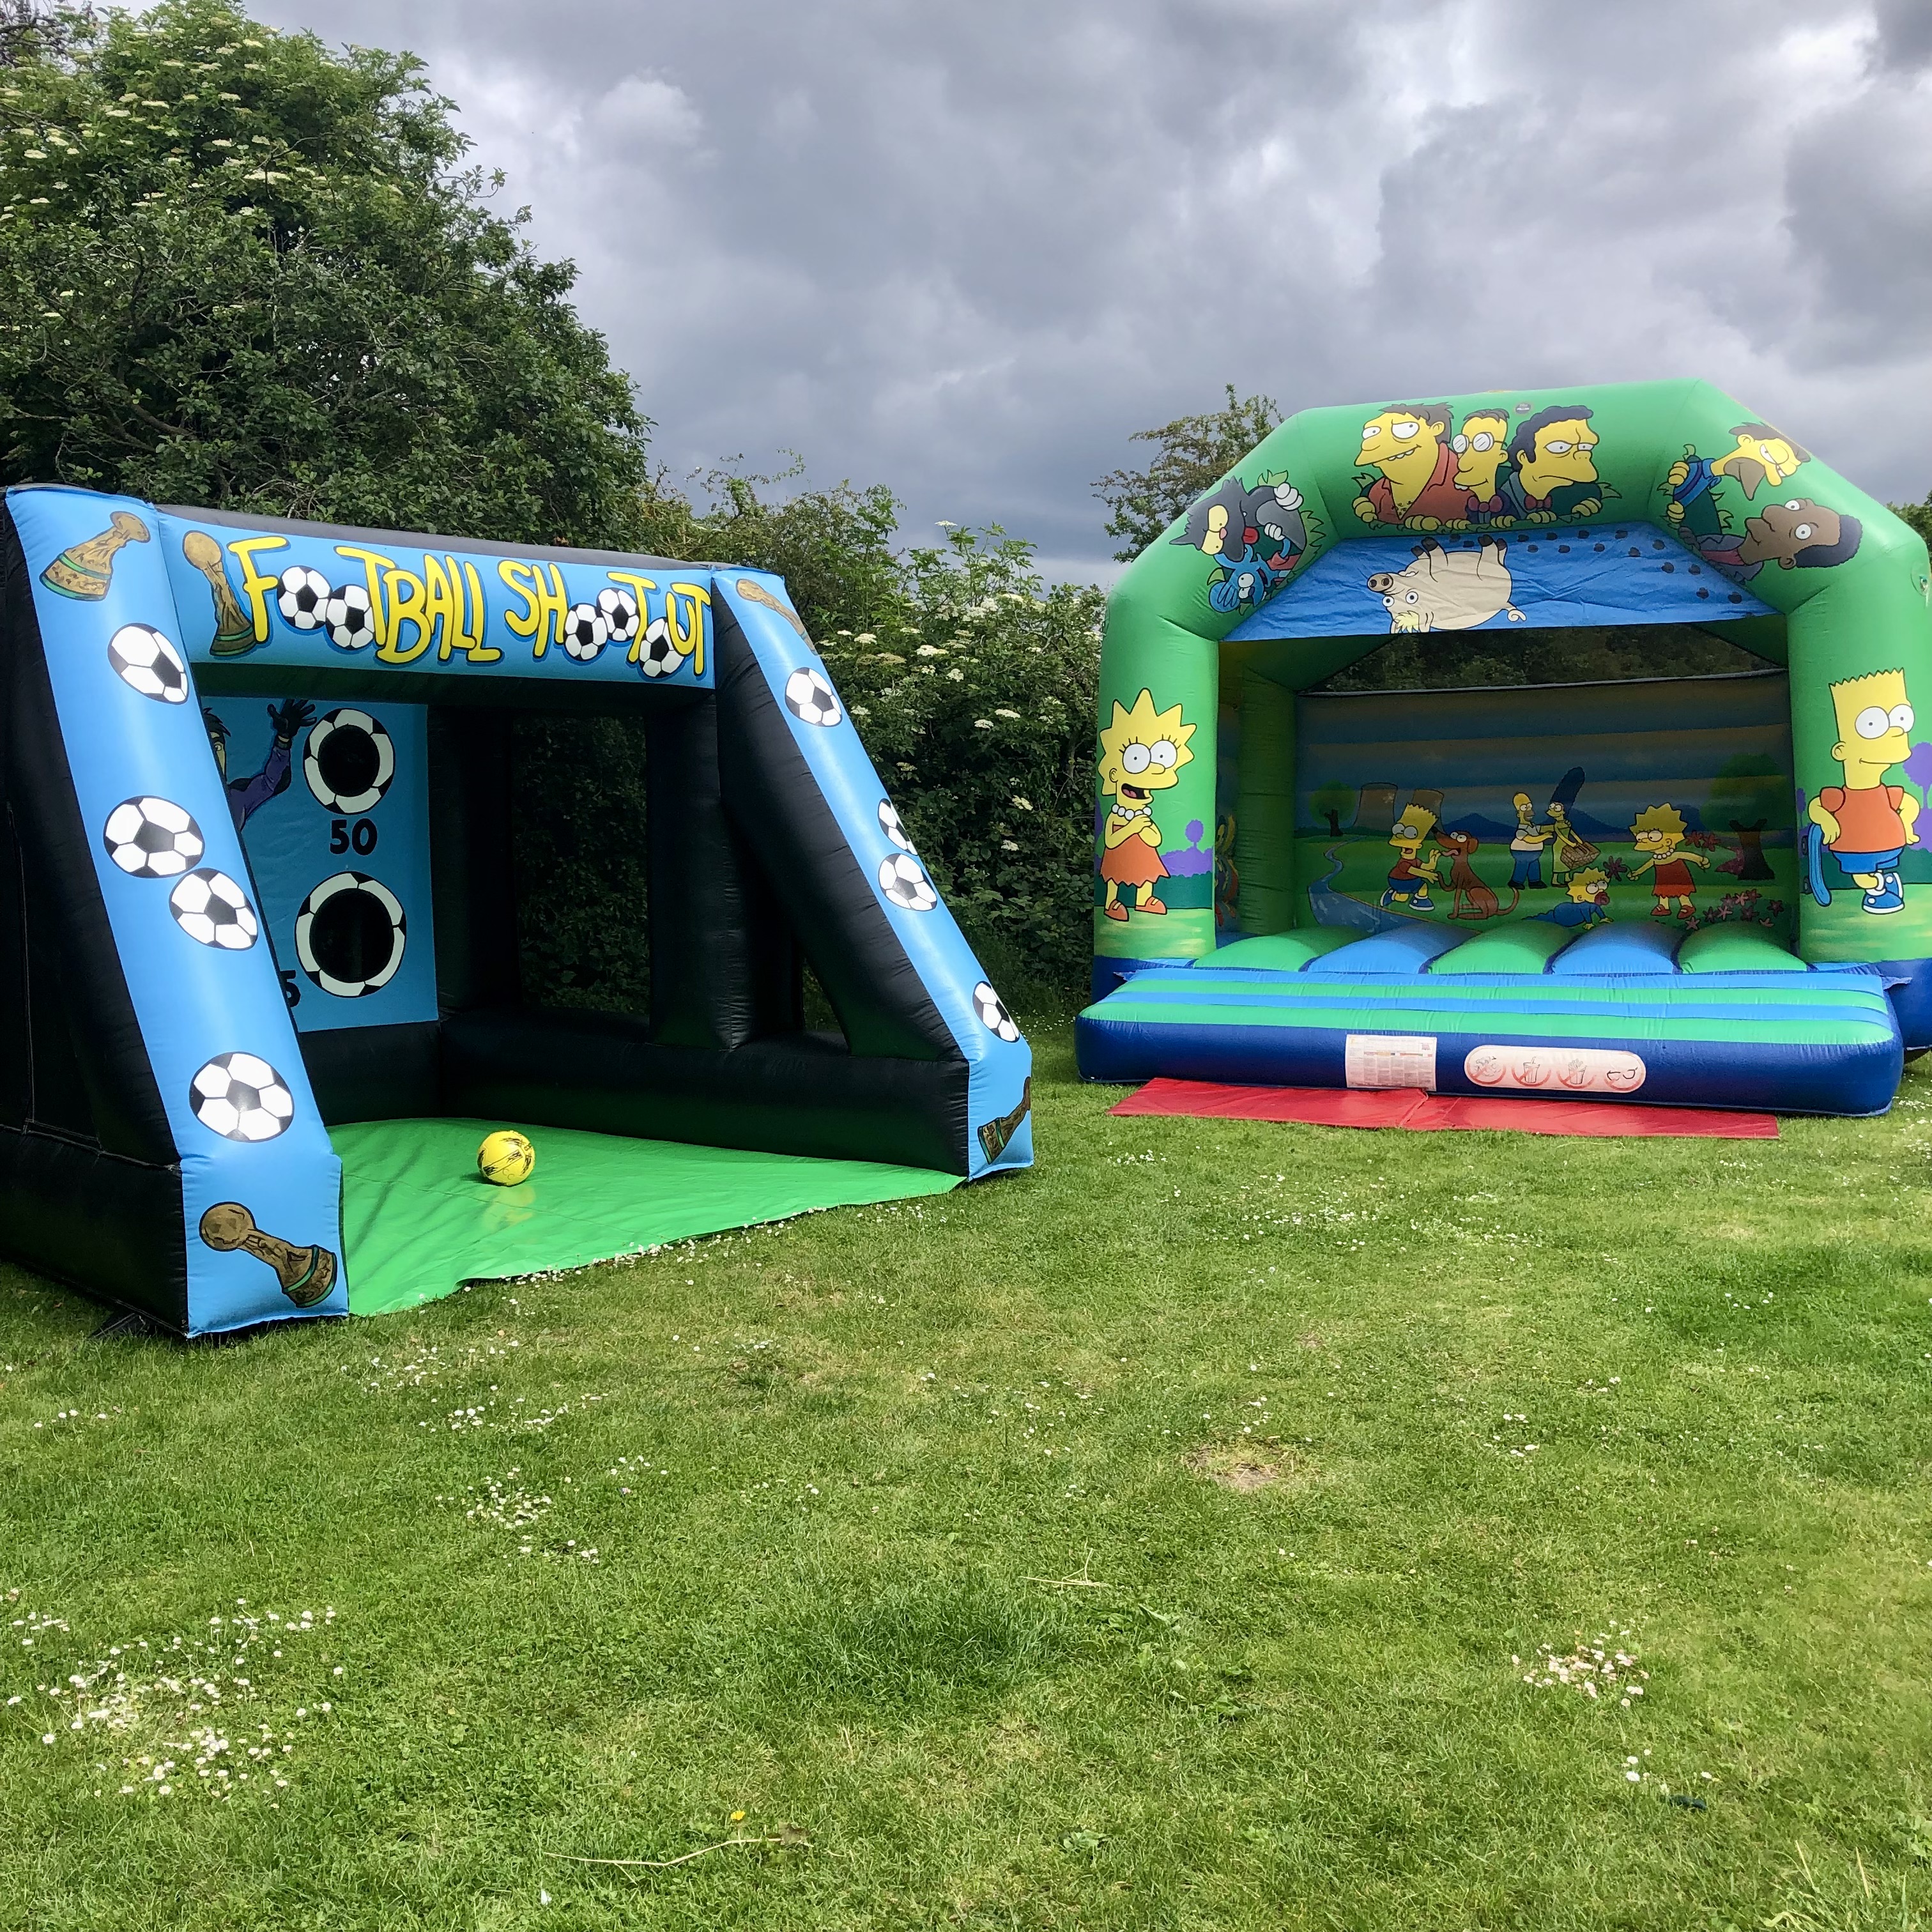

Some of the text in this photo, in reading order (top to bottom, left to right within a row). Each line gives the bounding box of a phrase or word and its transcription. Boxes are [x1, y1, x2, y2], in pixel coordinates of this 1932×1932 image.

[227, 536, 711, 678] FOOTBALL SHOOTOUT
[330, 818, 378, 855] 50
